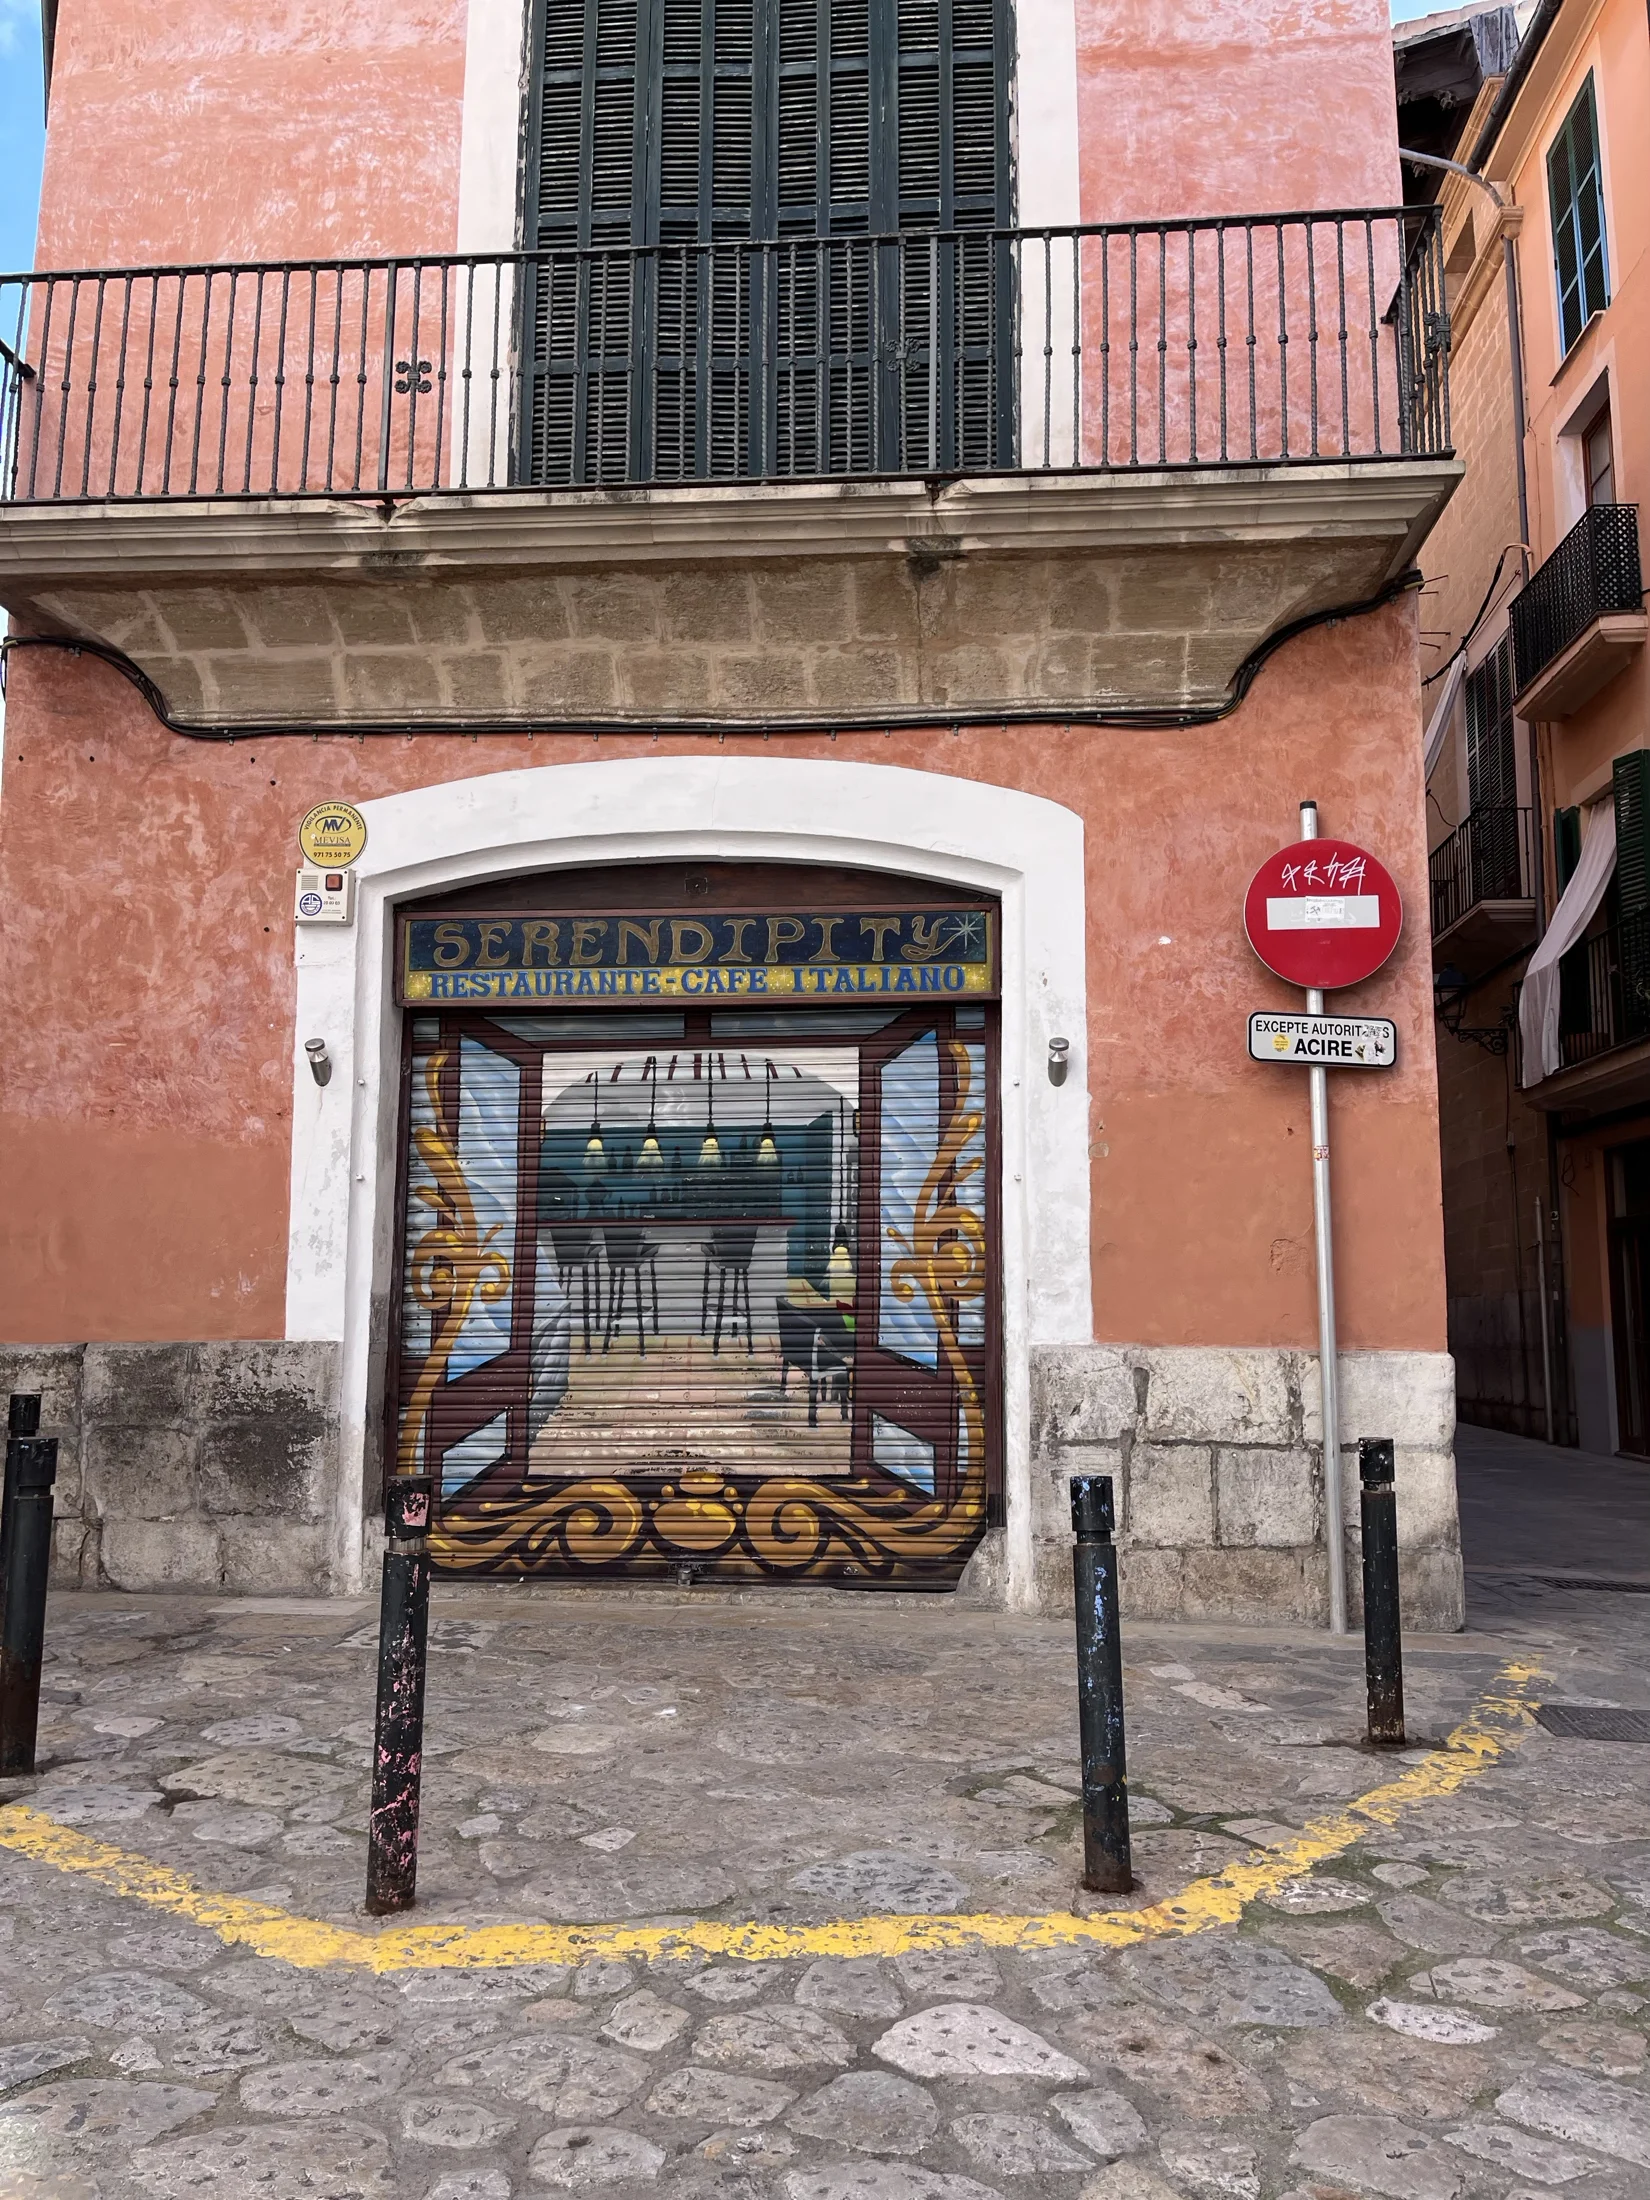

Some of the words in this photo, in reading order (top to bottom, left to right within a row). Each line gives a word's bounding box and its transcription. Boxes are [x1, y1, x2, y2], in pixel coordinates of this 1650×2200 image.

[304, 805, 332, 830] VIGILANCIA
[333, 805, 363, 830] PERMANENTE
[314, 836, 351, 844] MEVISA
[433, 915, 957, 966] SERENDIPITY
[792, 964, 966, 994] ITALIANO
[1255, 1020, 1309, 1034] EXCEPTE
[1312, 1023, 1390, 1038] AUTORITS
[1294, 1038, 1353, 1057] ACIRE
